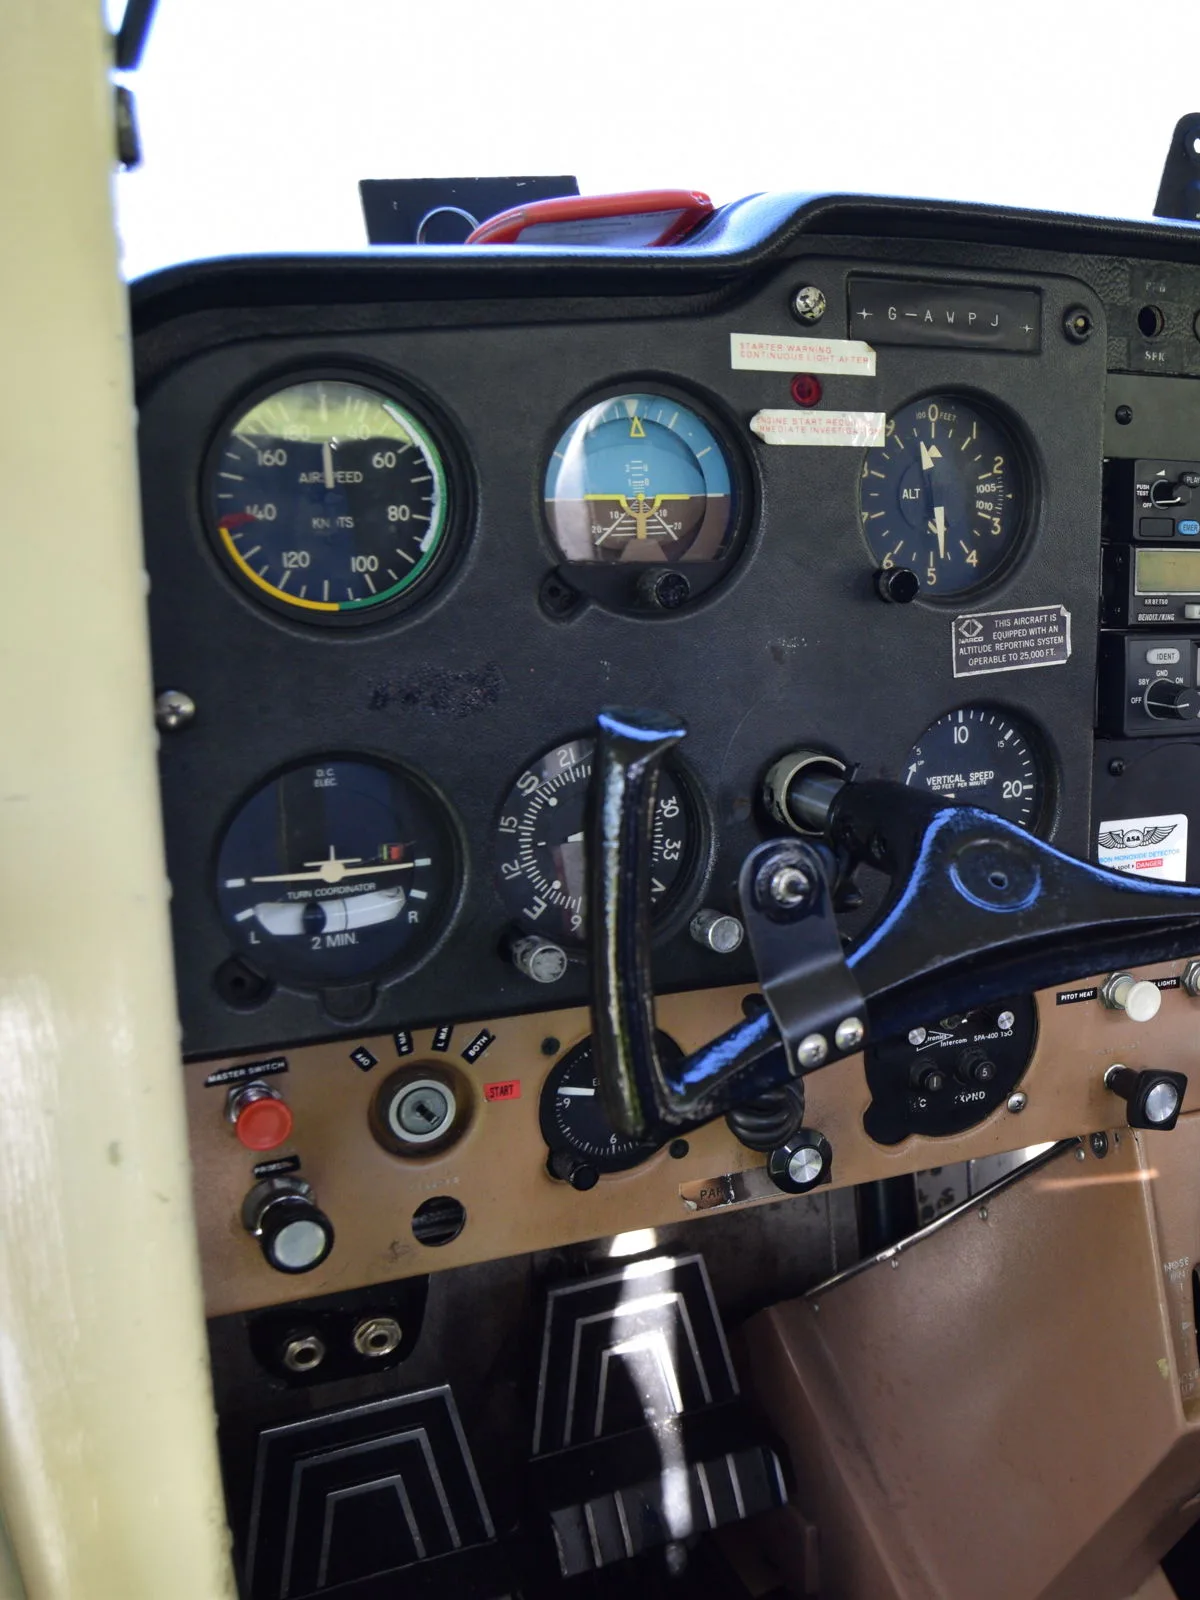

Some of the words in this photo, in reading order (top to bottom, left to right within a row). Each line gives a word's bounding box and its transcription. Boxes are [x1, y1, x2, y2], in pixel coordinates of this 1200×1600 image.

[786, 344, 832, 354] WARNING
[928, 403, 939, 422] 0
[257, 449, 287, 466] 160
[372, 452, 396, 469] 60
[993, 456, 1004, 474] 2
[1186, 475, 1200, 484] PLAY
[902, 488, 921, 500] ALT
[976, 484, 996, 494] 1005
[387, 505, 410, 522] 80
[976, 501, 994, 511] 1010
[312, 516, 355, 529] KNTS
[991, 517, 1001, 536] 3
[282, 551, 310, 568] 120
[351, 555, 379, 573] 100
[965, 549, 979, 568] 4
[926, 567, 937, 585] 5
[994, 619, 1011, 629] THIS
[1013, 615, 1048, 626] AIRCRAFT
[1049, 613, 1057, 622] IS
[1137, 613, 1175, 622] BENDIX/KING
[992, 630, 1028, 641] EQUIPPED
[1029, 627, 1047, 637] WITH
[1048, 625, 1059, 633] AN
[959, 644, 993, 656] ALTITUDE
[995, 638, 1035, 651] REPORTING
[1037, 635, 1064, 646] SYSTEM
[968, 655, 1007, 666] OPERABLE
[1009, 652, 1018, 661] TO
[1019, 649, 1045, 660] 25,000
[1156, 652, 1176, 661] IDENT
[1155, 669, 1169, 678] GND
[1175, 677, 1184, 685] ON
[1138, 678, 1150, 686] SBY
[954, 725, 969, 745] 10
[916, 748, 922, 756] 5
[997, 740, 1005, 748] 15
[556, 747, 576, 768] 21
[517, 770, 539, 797] S
[926, 774, 965, 786] VERTICAL
[969, 770, 995, 781] SPEED
[1002, 780, 1023, 799] 20
[660, 795, 680, 818] 30
[498, 815, 518, 833] 15
[663, 838, 682, 861] 33
[501, 859, 522, 881] 12
[1118, 863, 1131, 871] spot
[1136, 859, 1163, 869] DANGER
[287, 889, 312, 900] TURN
[314, 882, 376, 898] COORDINATOR
[522, 895, 547, 920] E
[408, 911, 419, 923] R
[250, 932, 260, 945] L
[312, 936, 322, 950] 2
[326, 932, 359, 949] MIN.
[1157, 979, 1177, 987] LIGHTS
[1060, 993, 1078, 1001] PITOT
[1079, 990, 1094, 999] HEAT
[940, 1037, 968, 1047] Intercom
[973, 1032, 999, 1042] SPA-400
[468, 1035, 489, 1058] BOTH
[207, 1069, 246, 1083] MASTER
[247, 1061, 285, 1074] SWITCH
[982, 1067, 988, 1077] 5
[489, 1083, 515, 1099] START
[562, 1097, 572, 1109] 9
[609, 1133, 618, 1145] 6
[1164, 1256, 1190, 1272] NOSE
